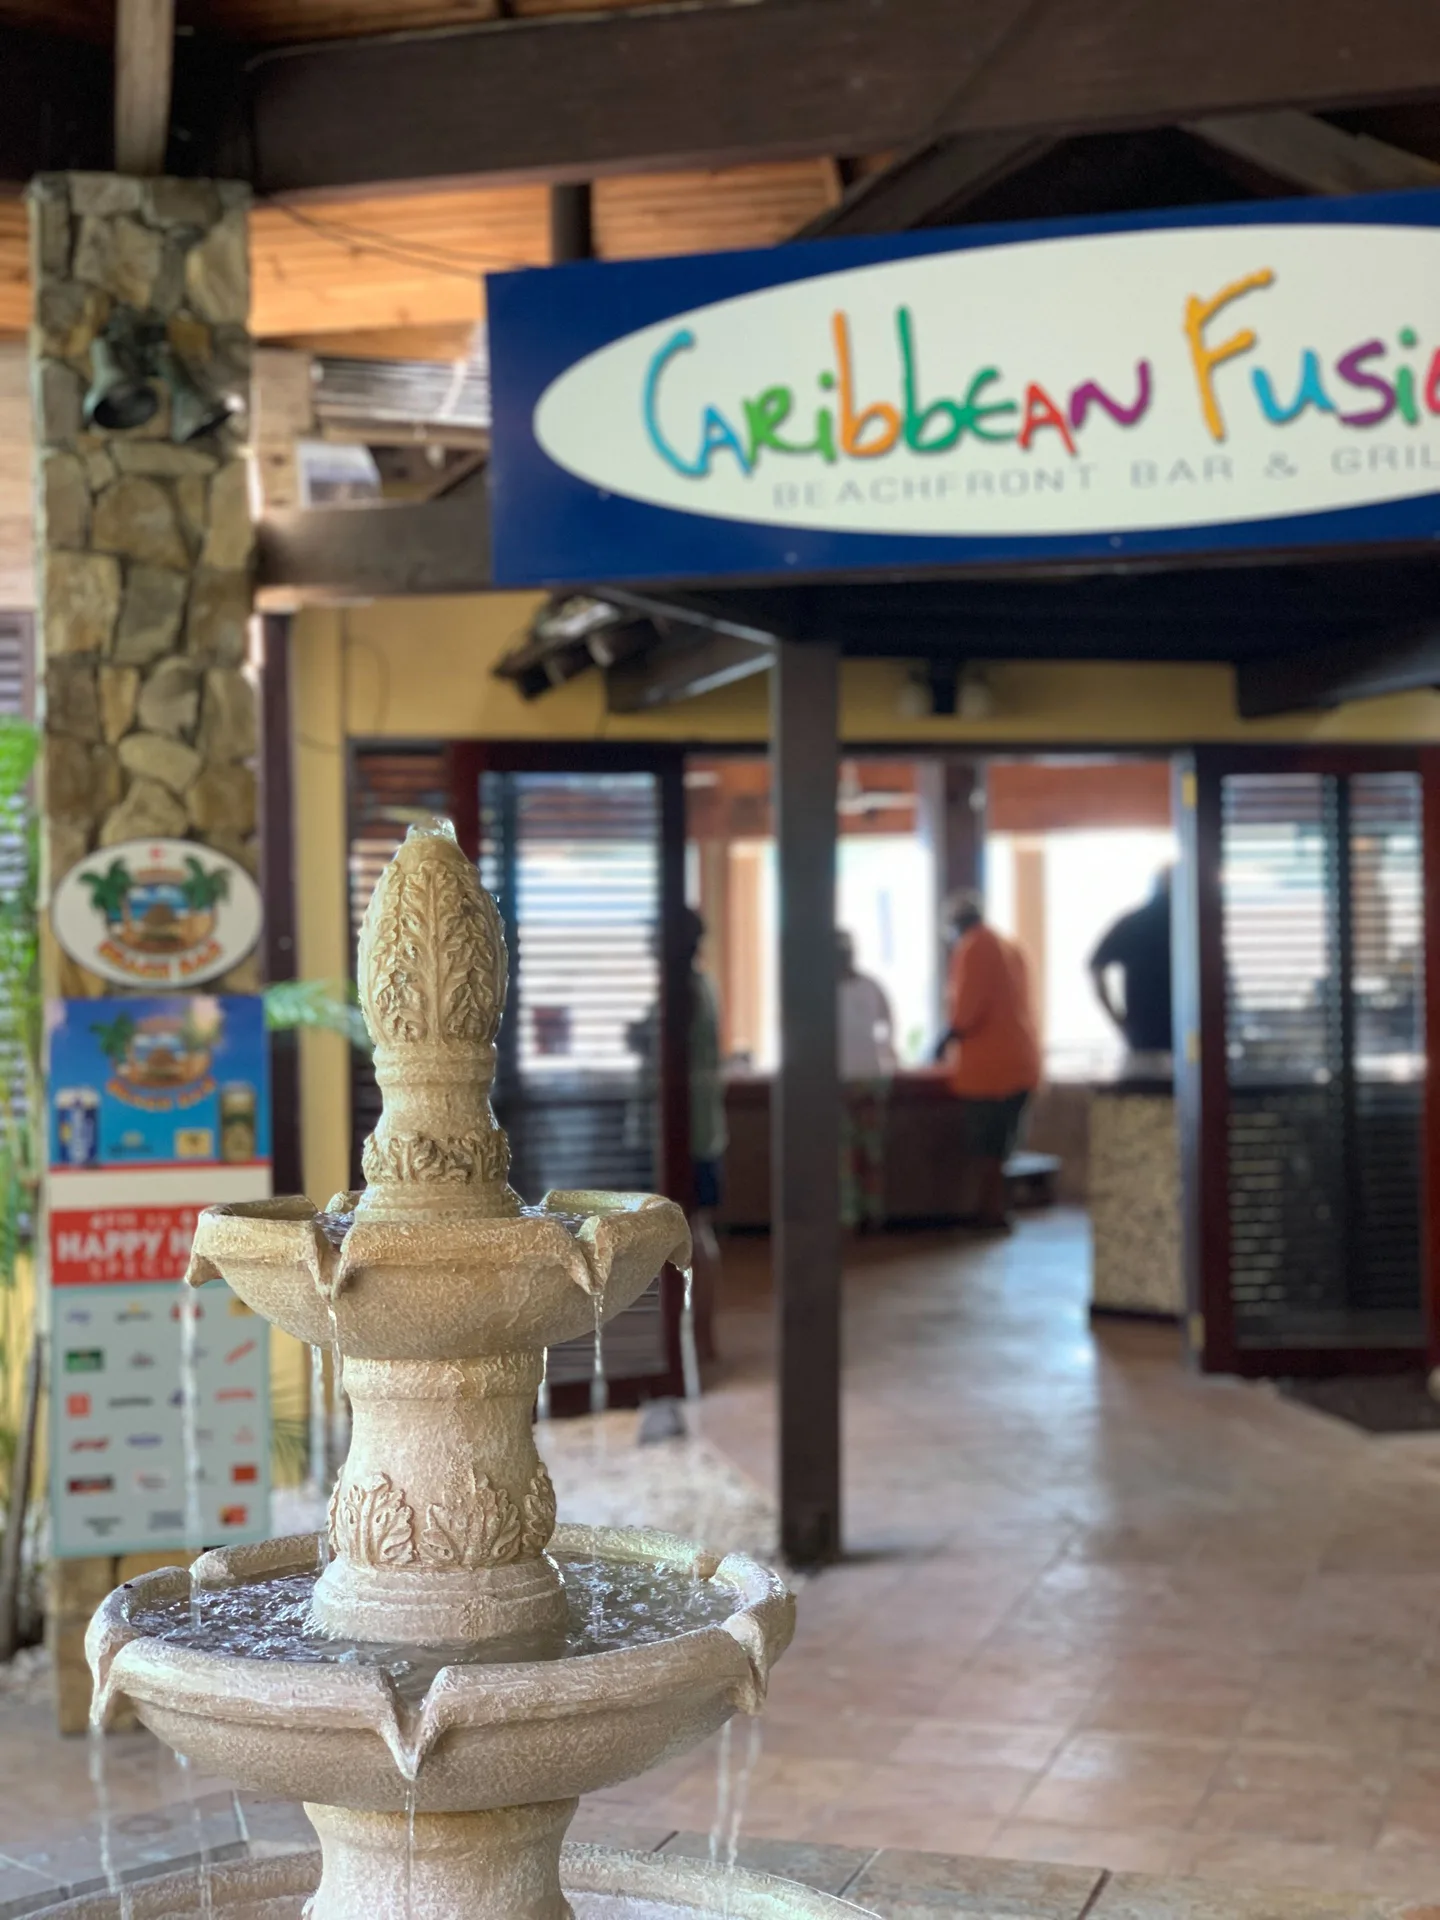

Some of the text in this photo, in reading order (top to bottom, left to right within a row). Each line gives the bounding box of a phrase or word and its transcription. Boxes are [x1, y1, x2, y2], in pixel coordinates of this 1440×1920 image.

[771, 443, 1440, 509] BEACHFRONT BAR & GRIL
[56, 1228, 164, 1263] HAPPY
